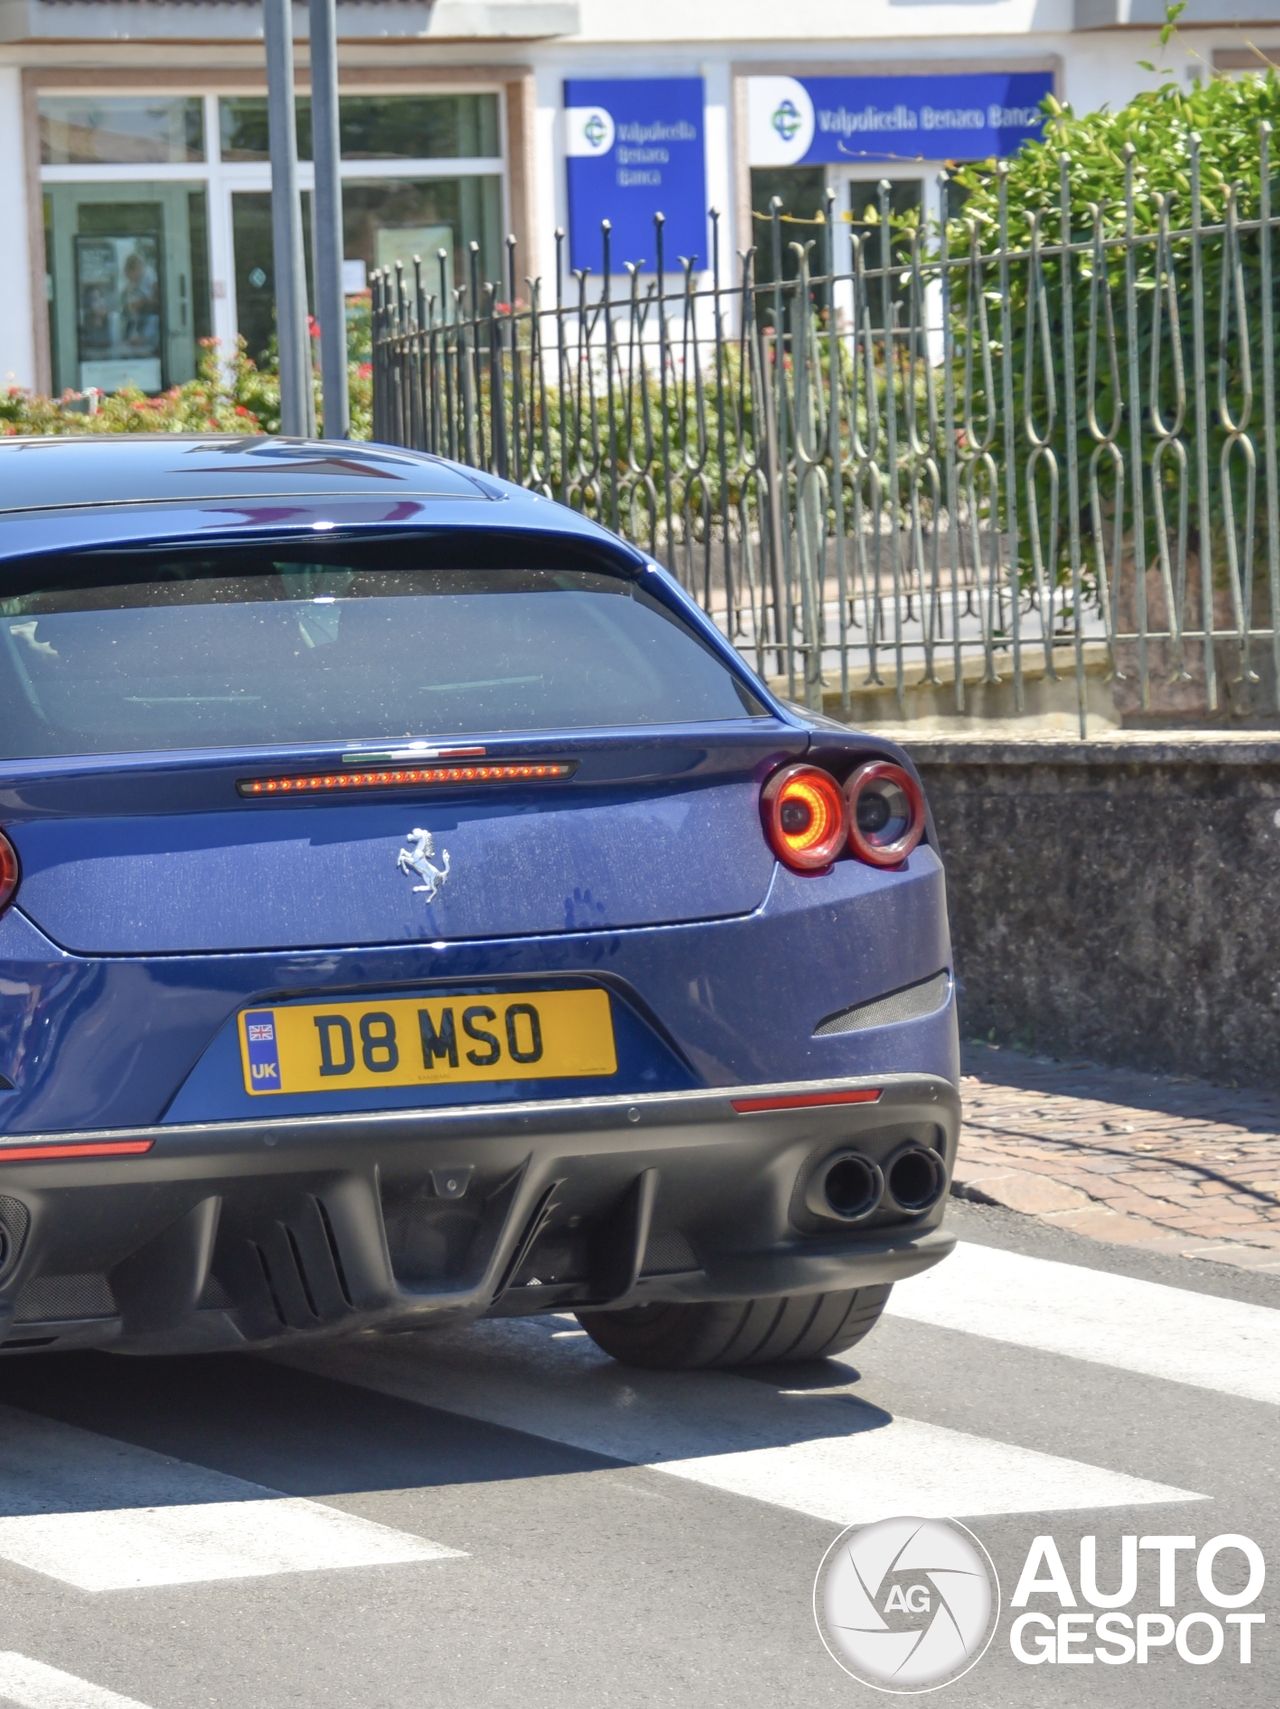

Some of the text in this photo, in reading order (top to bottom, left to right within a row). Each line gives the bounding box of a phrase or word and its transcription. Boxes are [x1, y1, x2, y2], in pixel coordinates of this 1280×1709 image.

[818, 103, 1041, 137] Valpolicella Benaco Banca
[616, 120, 696, 144] Valpolicella
[616, 145, 669, 164] Benaco
[616, 167, 661, 186] Banca
[313, 1003, 544, 1077] D8 MSO
[252, 1063, 277, 1080] UK
